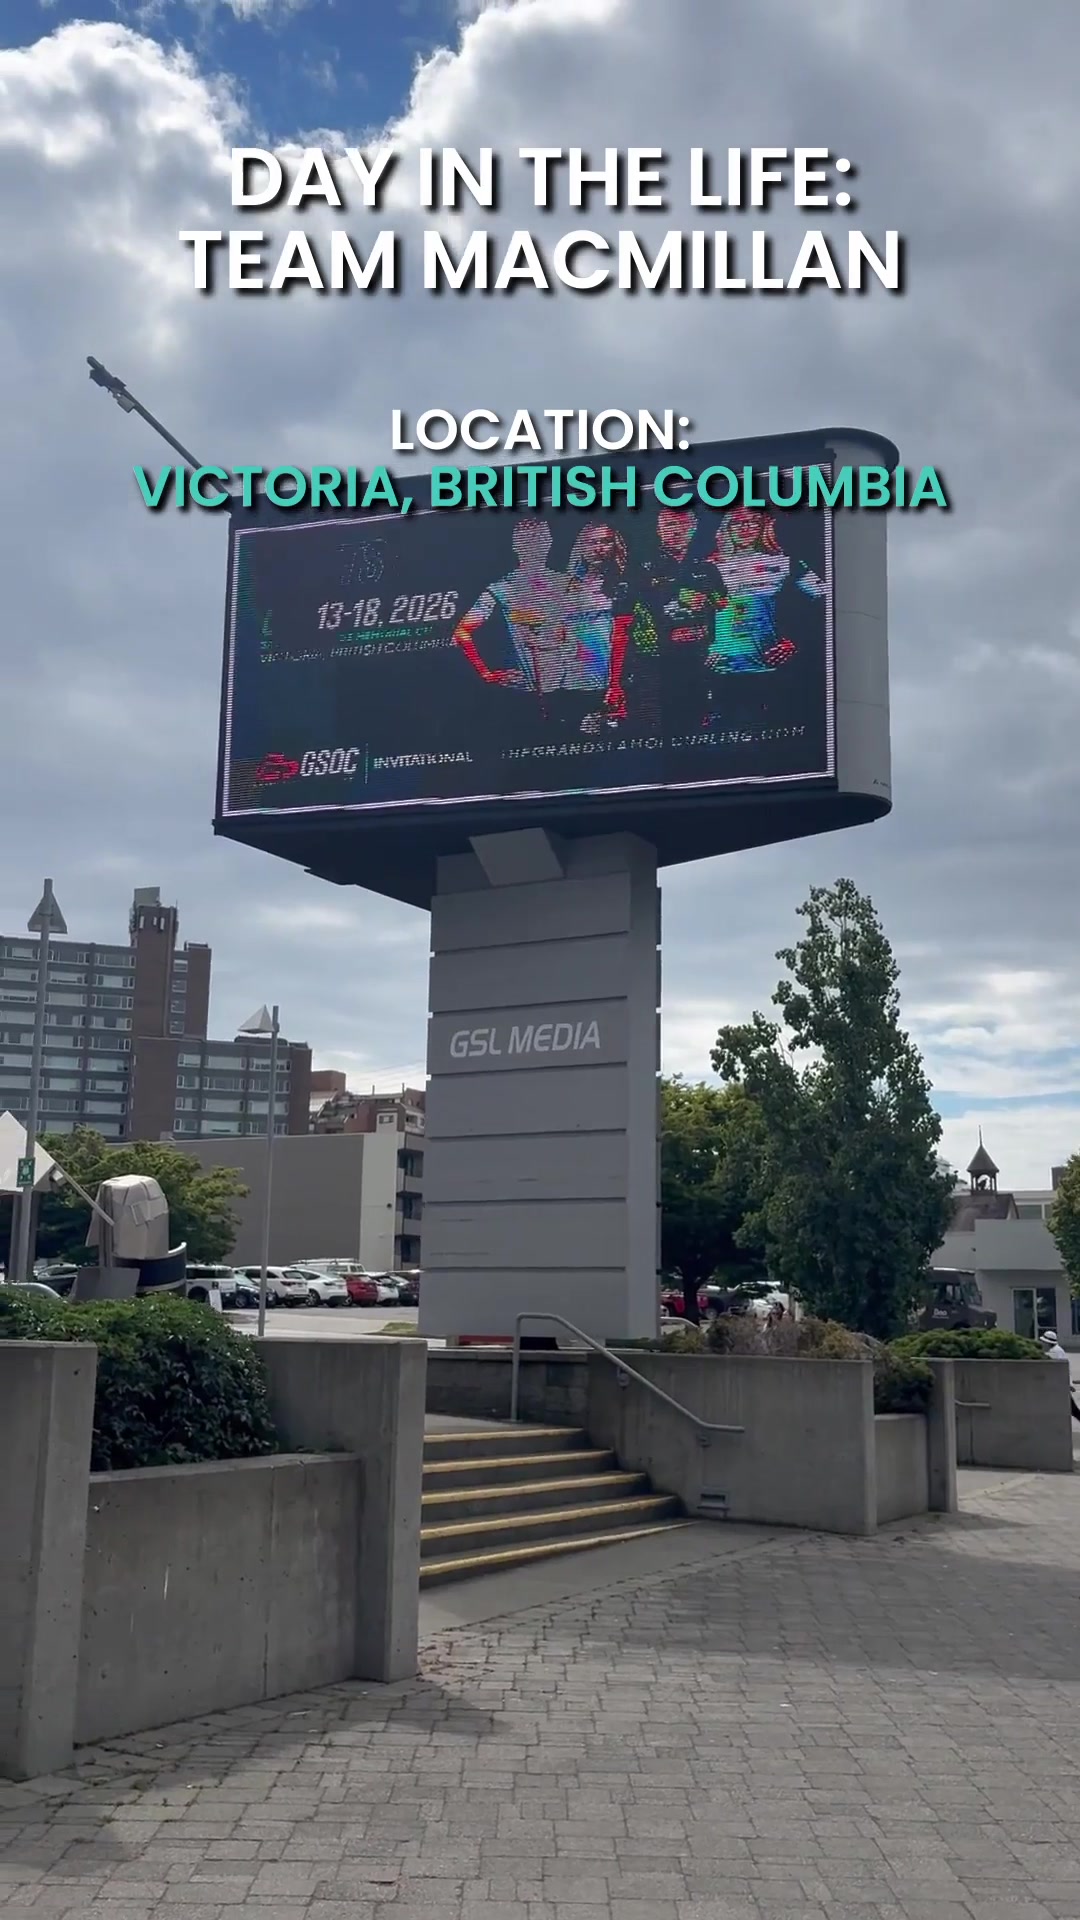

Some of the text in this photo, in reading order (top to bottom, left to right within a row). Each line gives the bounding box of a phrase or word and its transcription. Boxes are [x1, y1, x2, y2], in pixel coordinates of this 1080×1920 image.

[317, 590, 459, 630] 13-18, 2026
[300, 747, 360, 777] GSOC
[373, 751, 473, 769] INVITATIONAL
[450, 1020, 601, 1058] GSL MEDIA
